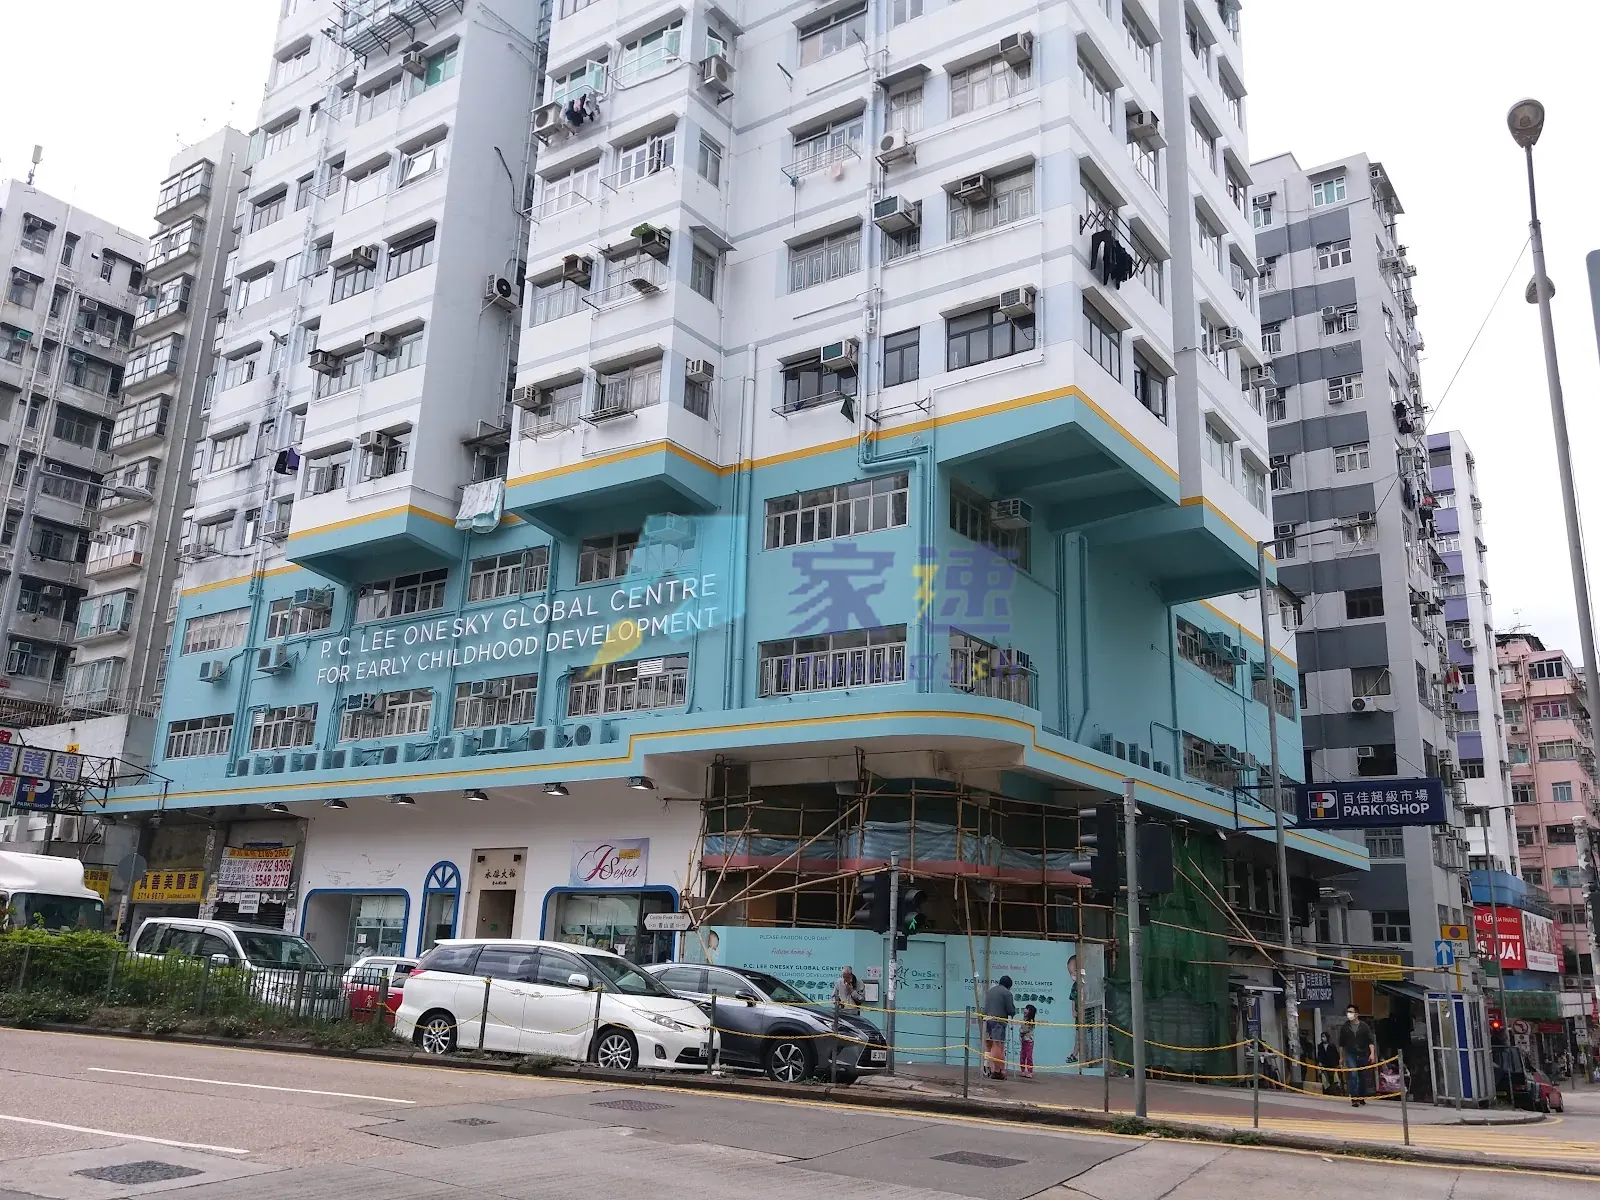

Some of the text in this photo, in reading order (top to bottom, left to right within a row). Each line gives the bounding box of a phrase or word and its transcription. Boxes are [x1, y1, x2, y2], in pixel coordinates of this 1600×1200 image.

[321, 640, 331, 659] P.
[338, 637, 350, 656] C.
[360, 629, 397, 653] LEE
[503, 594, 599, 630] GLOBAL
[610, 573, 716, 611] CENTRE
[317, 607, 718, 685] FOR EARLY CHILDHOOD DEVELOPMENT
[1342, 788, 1429, 804] 百佳超級市場
[255, 875, 272, 887] 5548
